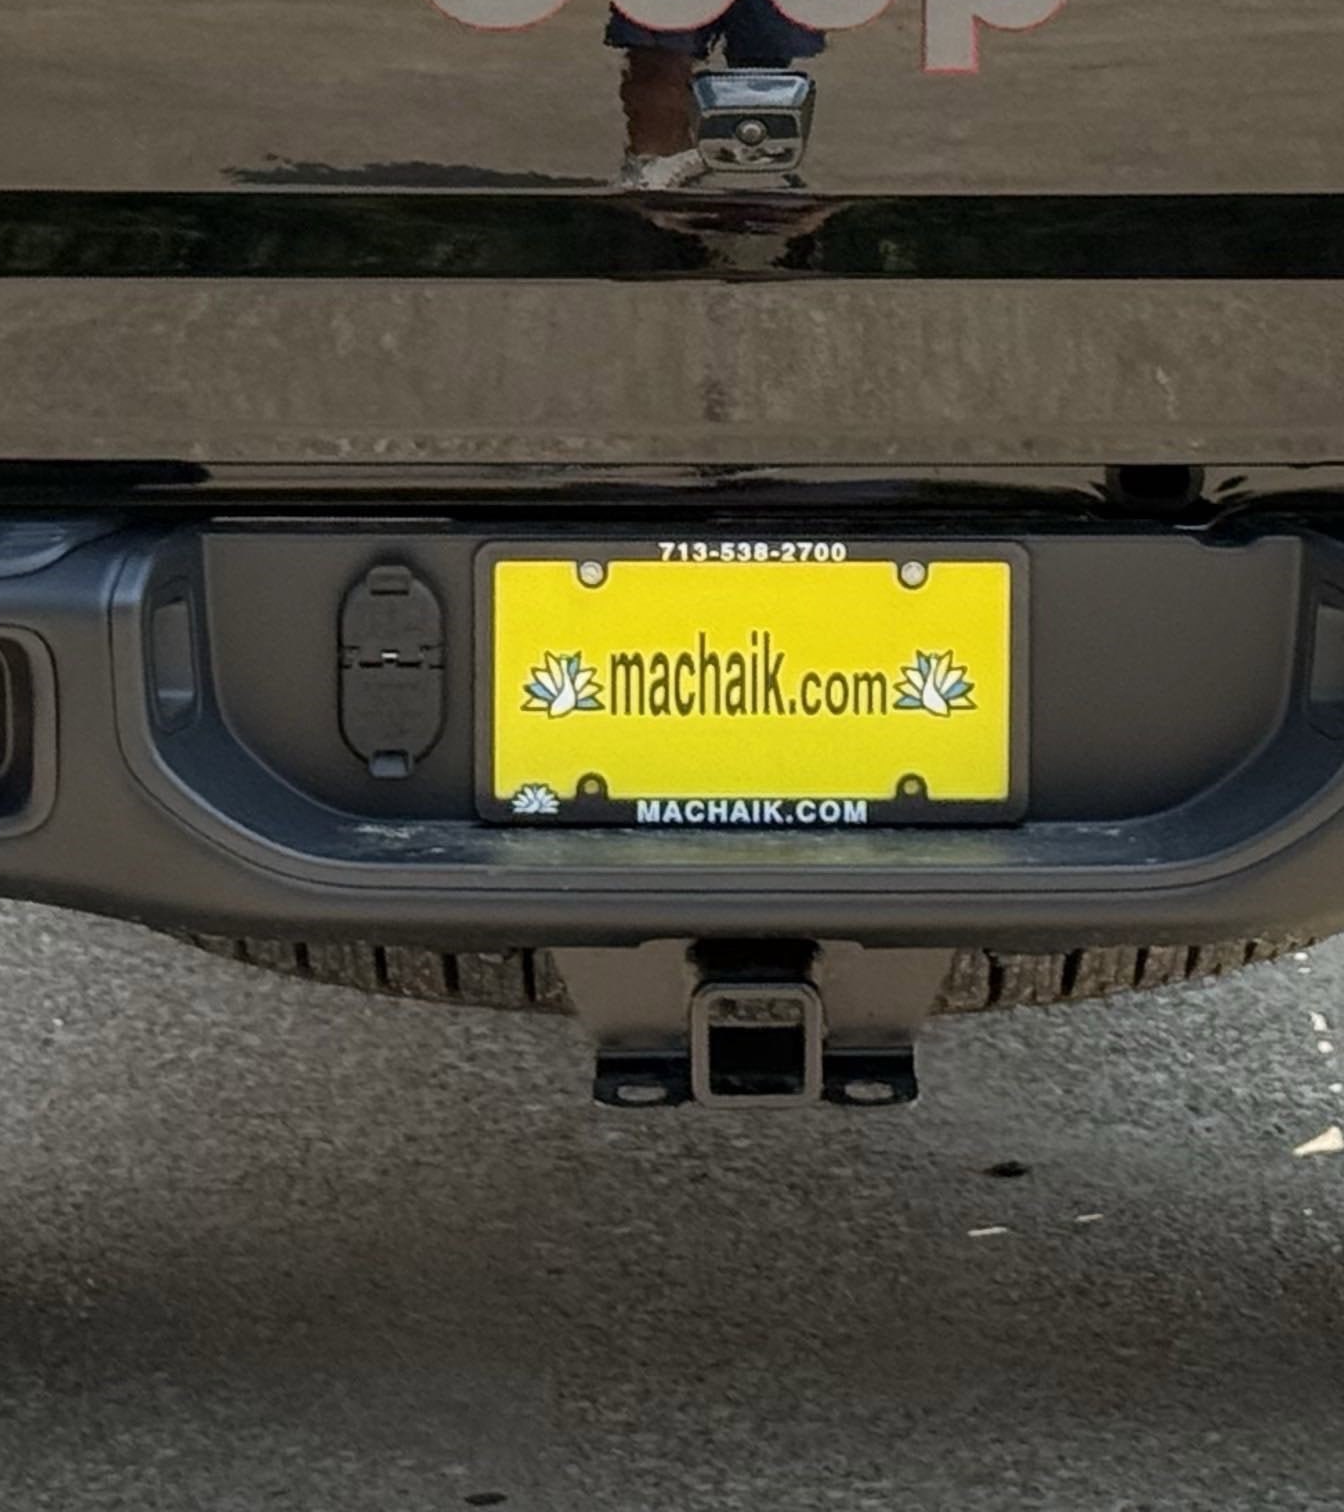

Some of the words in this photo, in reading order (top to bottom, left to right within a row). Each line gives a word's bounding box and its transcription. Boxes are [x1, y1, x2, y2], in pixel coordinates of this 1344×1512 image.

[658, 543, 847, 561] 713-538-2700
[609, 631, 888, 715] machaik.com
[637, 800, 868, 823] MACHAIK.COM
